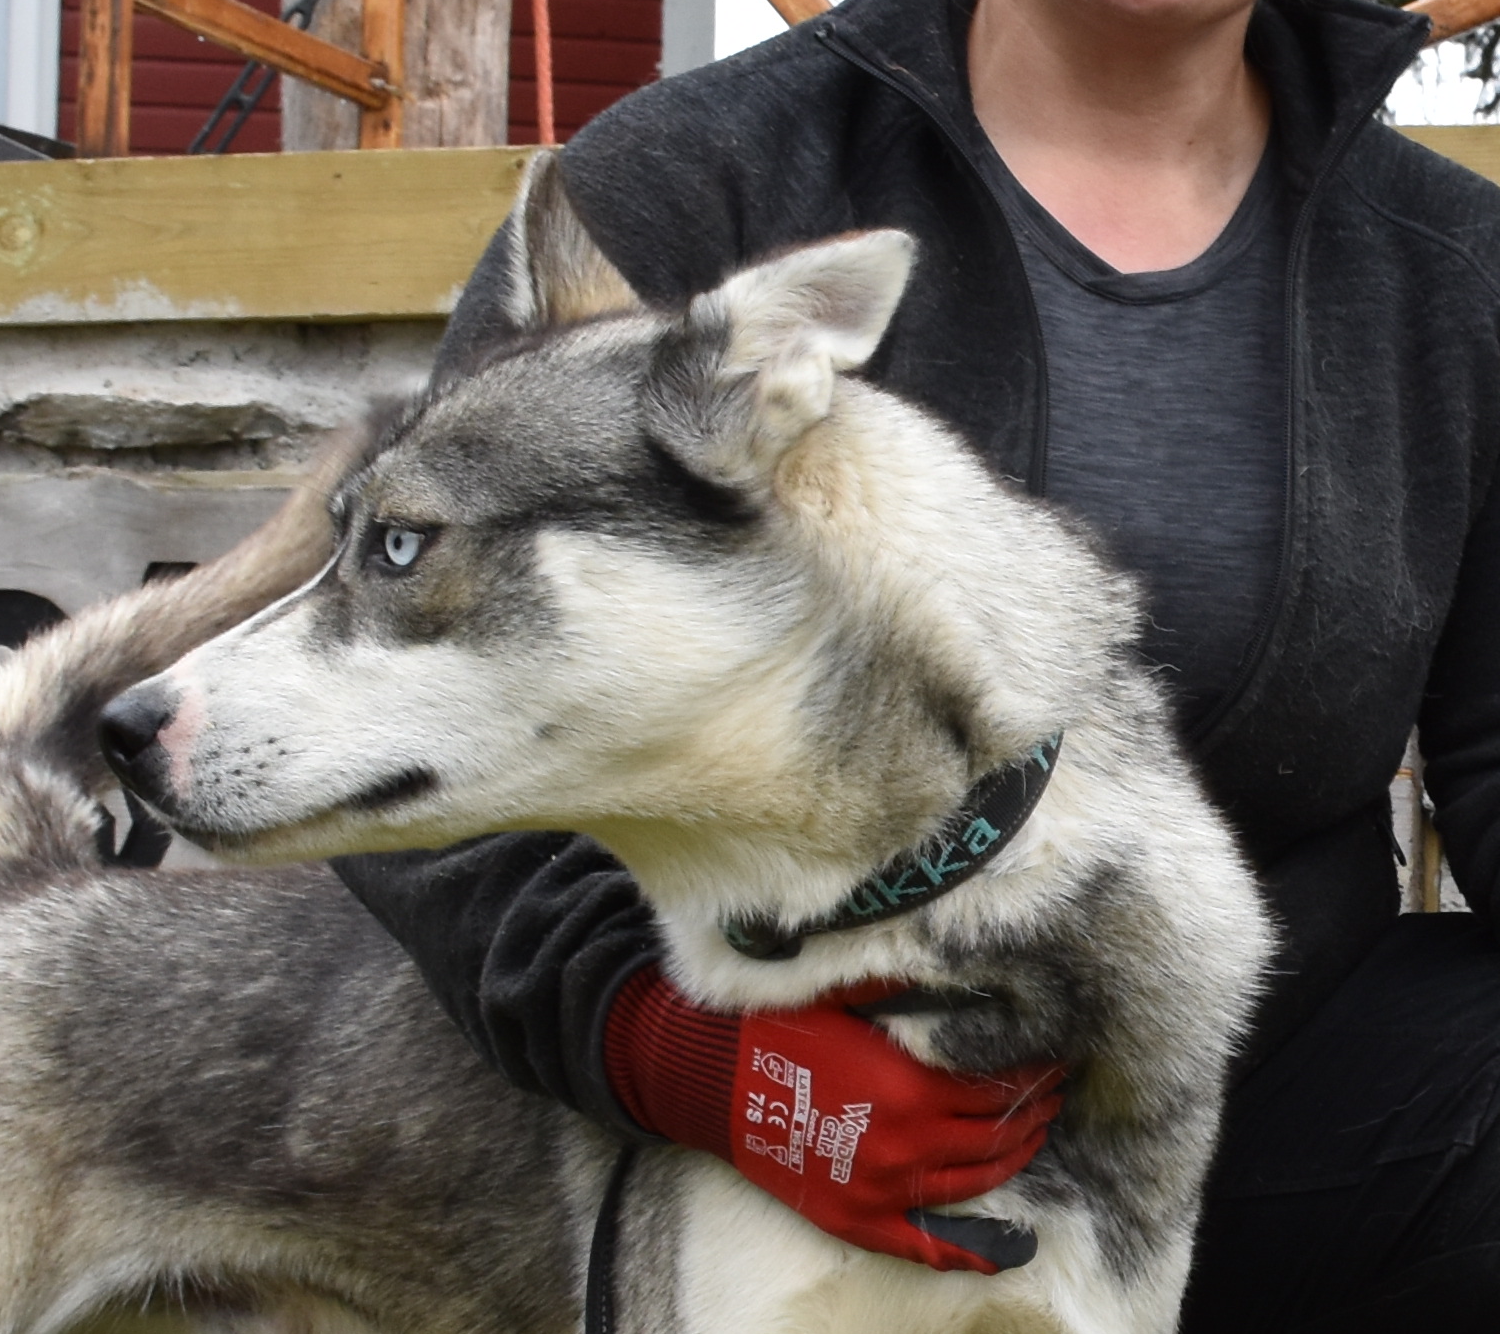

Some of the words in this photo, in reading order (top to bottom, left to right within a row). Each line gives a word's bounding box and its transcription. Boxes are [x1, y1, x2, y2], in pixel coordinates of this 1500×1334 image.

[746, 1091, 766, 1124] 7/S
[797, 1074, 810, 1116] LATEX
[817, 1116, 840, 1157] GRIP
[831, 1103, 872, 1184] WONDER
